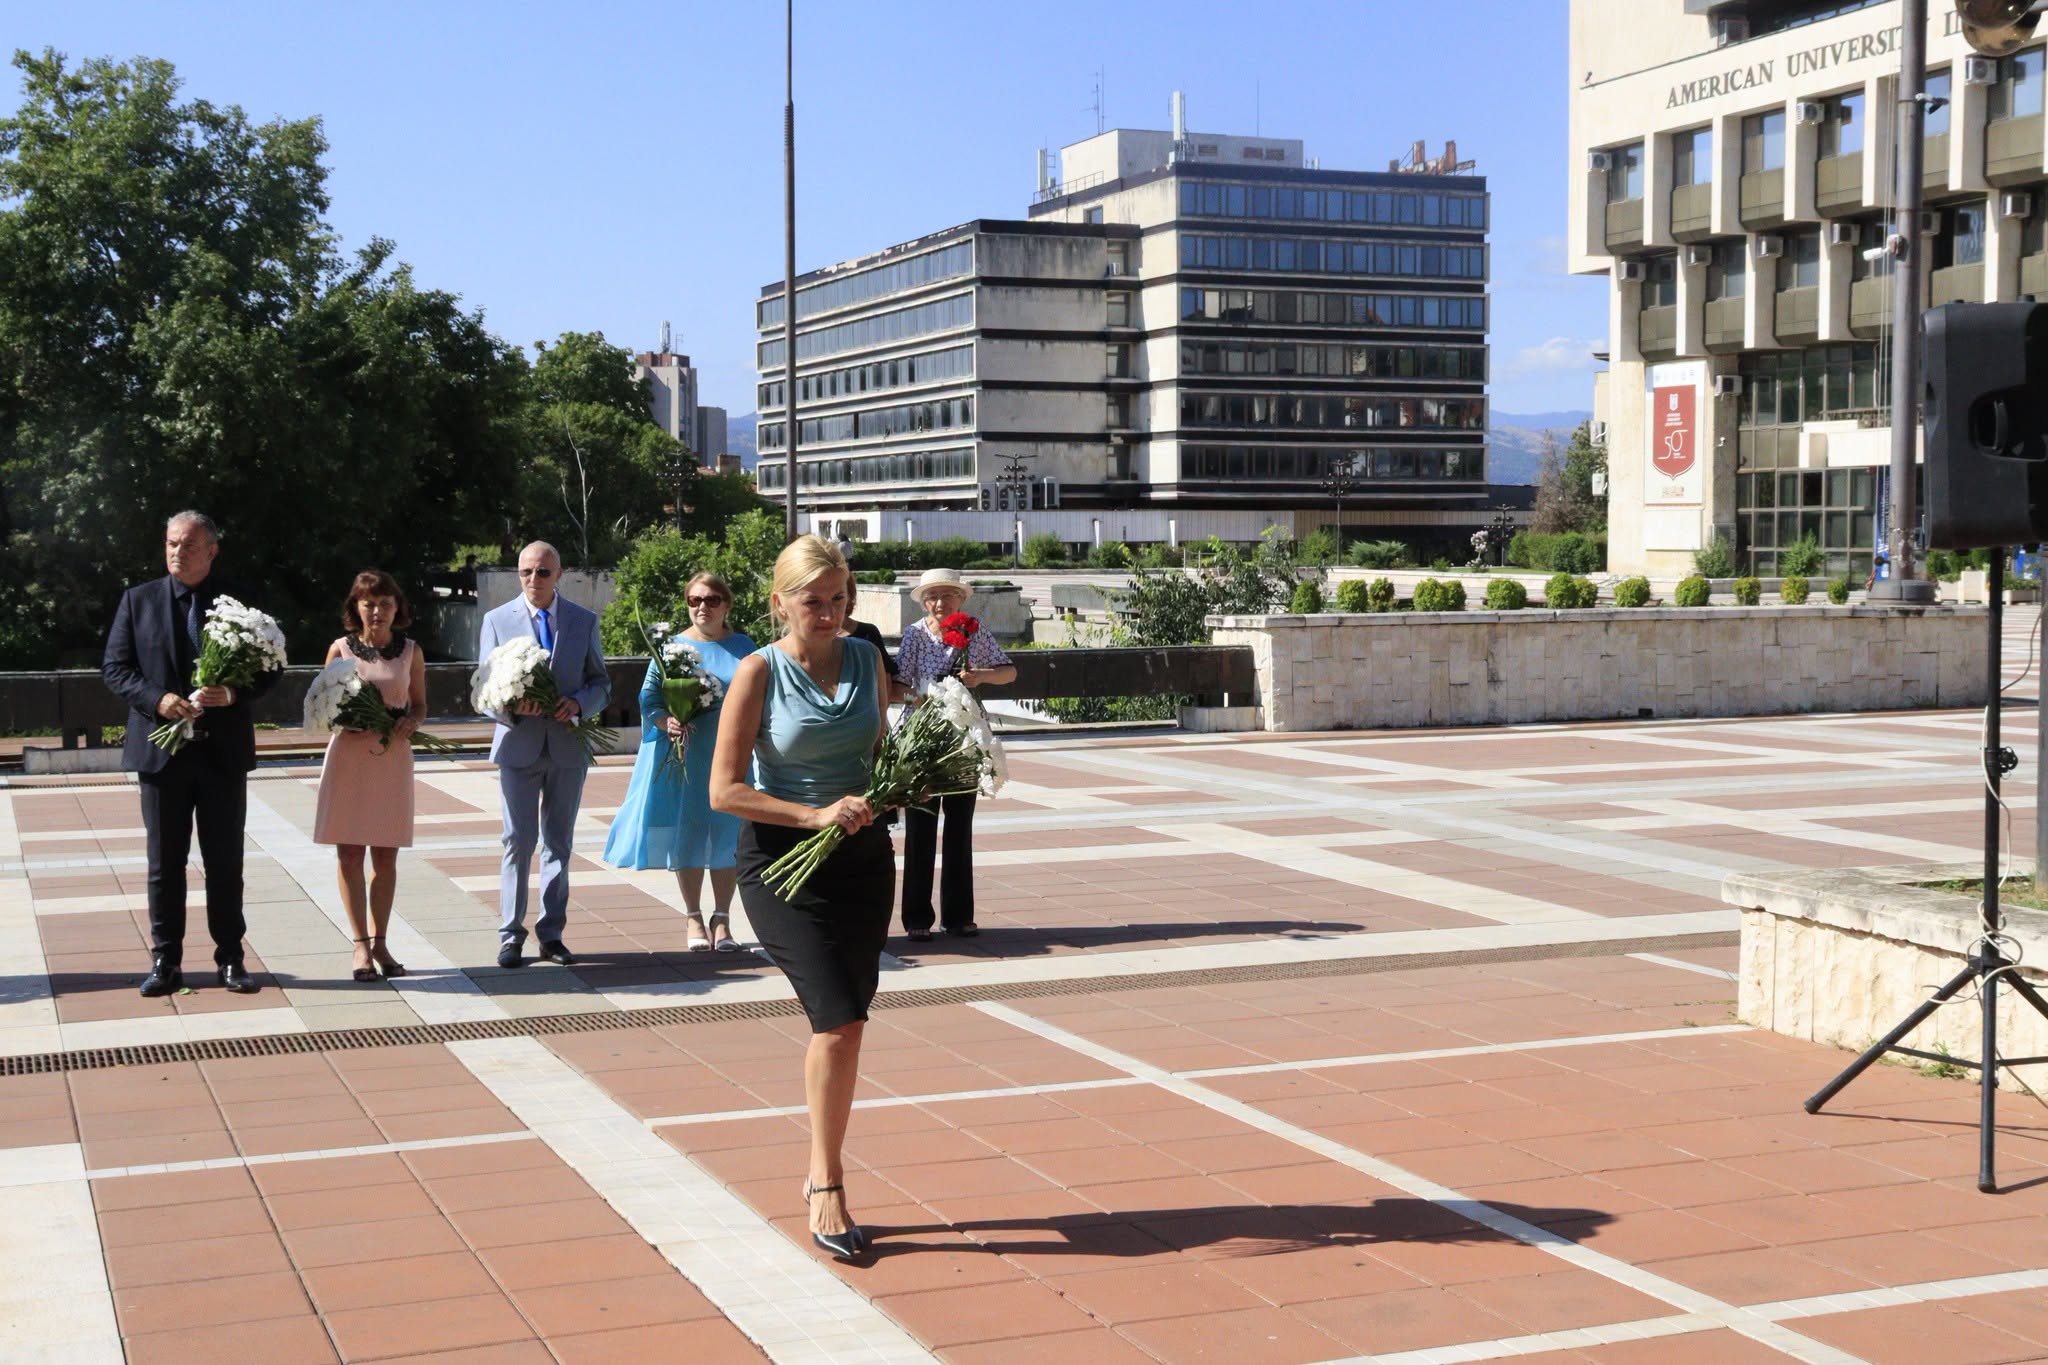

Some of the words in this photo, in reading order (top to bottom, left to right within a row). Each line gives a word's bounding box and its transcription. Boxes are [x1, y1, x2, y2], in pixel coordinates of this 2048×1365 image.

[1666, 60, 1774, 109] AMERICAN
[1787, 25, 1903, 77] UNIVERSI
[1658, 429, 1689, 460] 50
